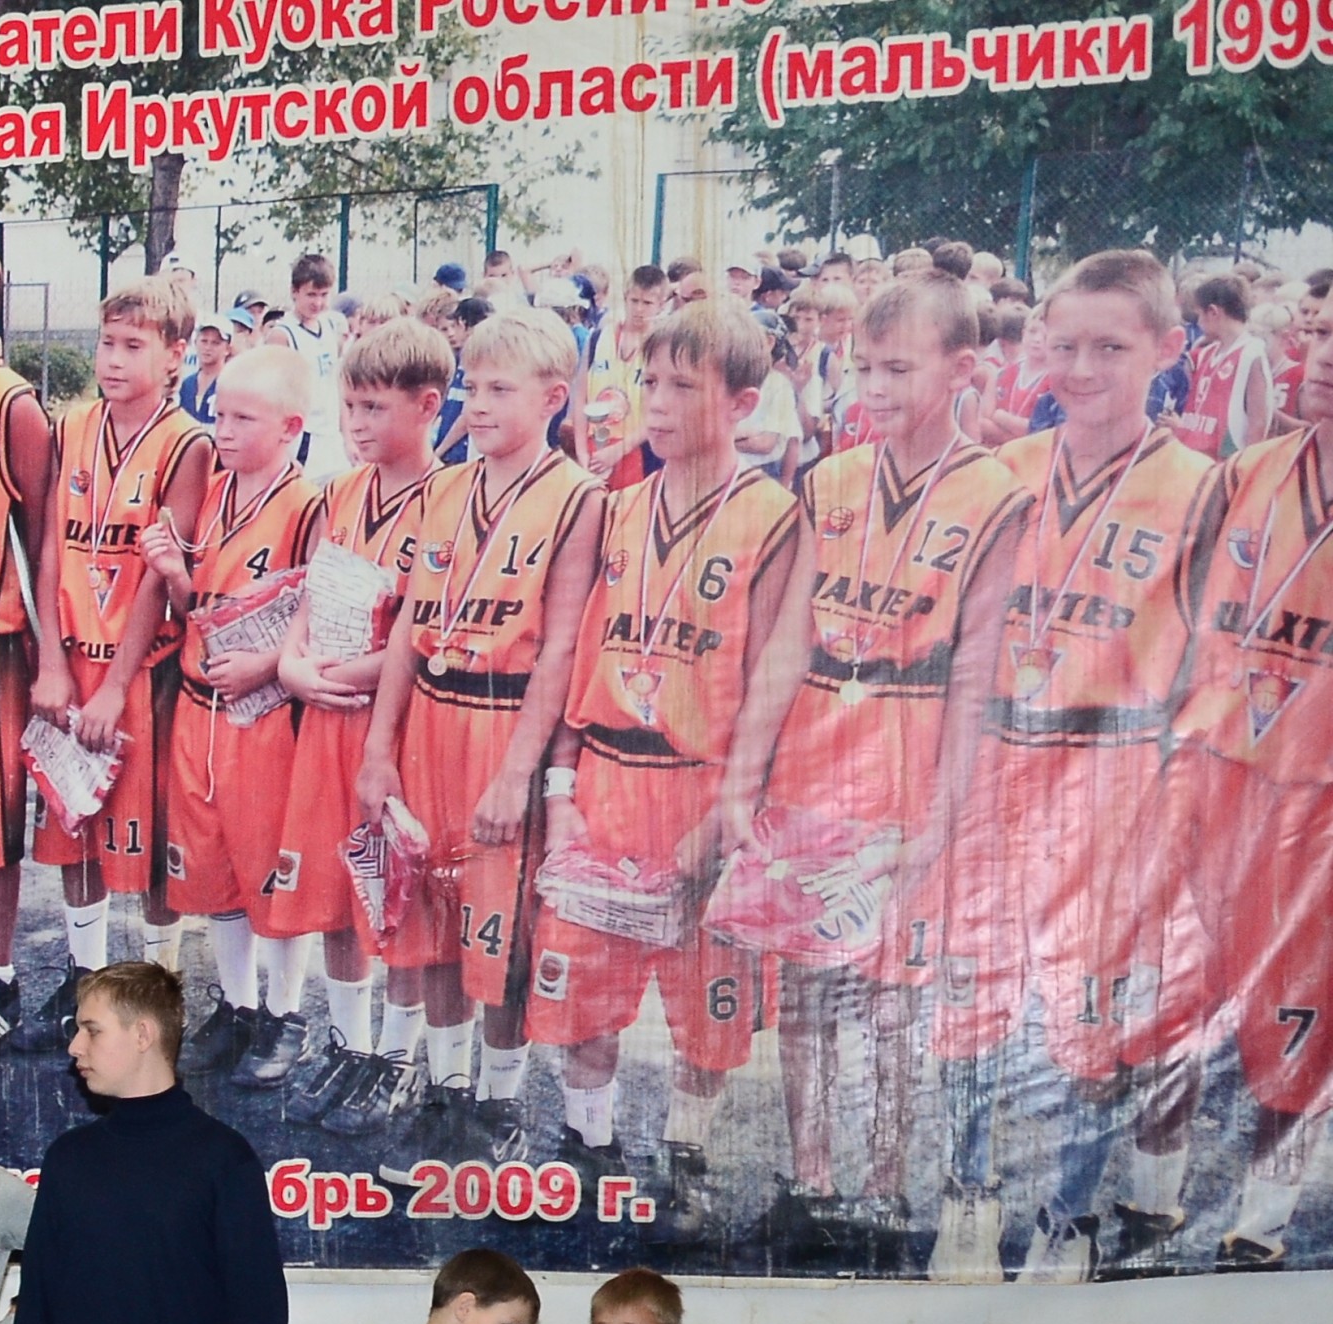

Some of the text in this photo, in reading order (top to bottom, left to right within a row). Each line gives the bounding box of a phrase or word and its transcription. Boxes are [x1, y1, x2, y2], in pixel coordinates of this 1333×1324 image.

[203, 0, 393, 64] Кубка
[420, 0, 667, 32] Рос
[86, 63, 429, 167] Иркутской
[452, 54, 733, 125] области
[761, 22, 1147, 121] (мальчики
[247, 547, 271, 580] 4
[912, 519, 971, 573] 12
[1093, 522, 1164, 580] 15
[697, 556, 733, 601] 6
[104, 817, 143, 855] 11
[460, 905, 505, 956] 14
[707, 976, 738, 1022] 6
[1278, 1008, 1316, 1057] 7
[269, 1164, 389, 1225] брь
[410, 1166, 580, 1217] 2009
[602, 1181, 651, 1218] г.
